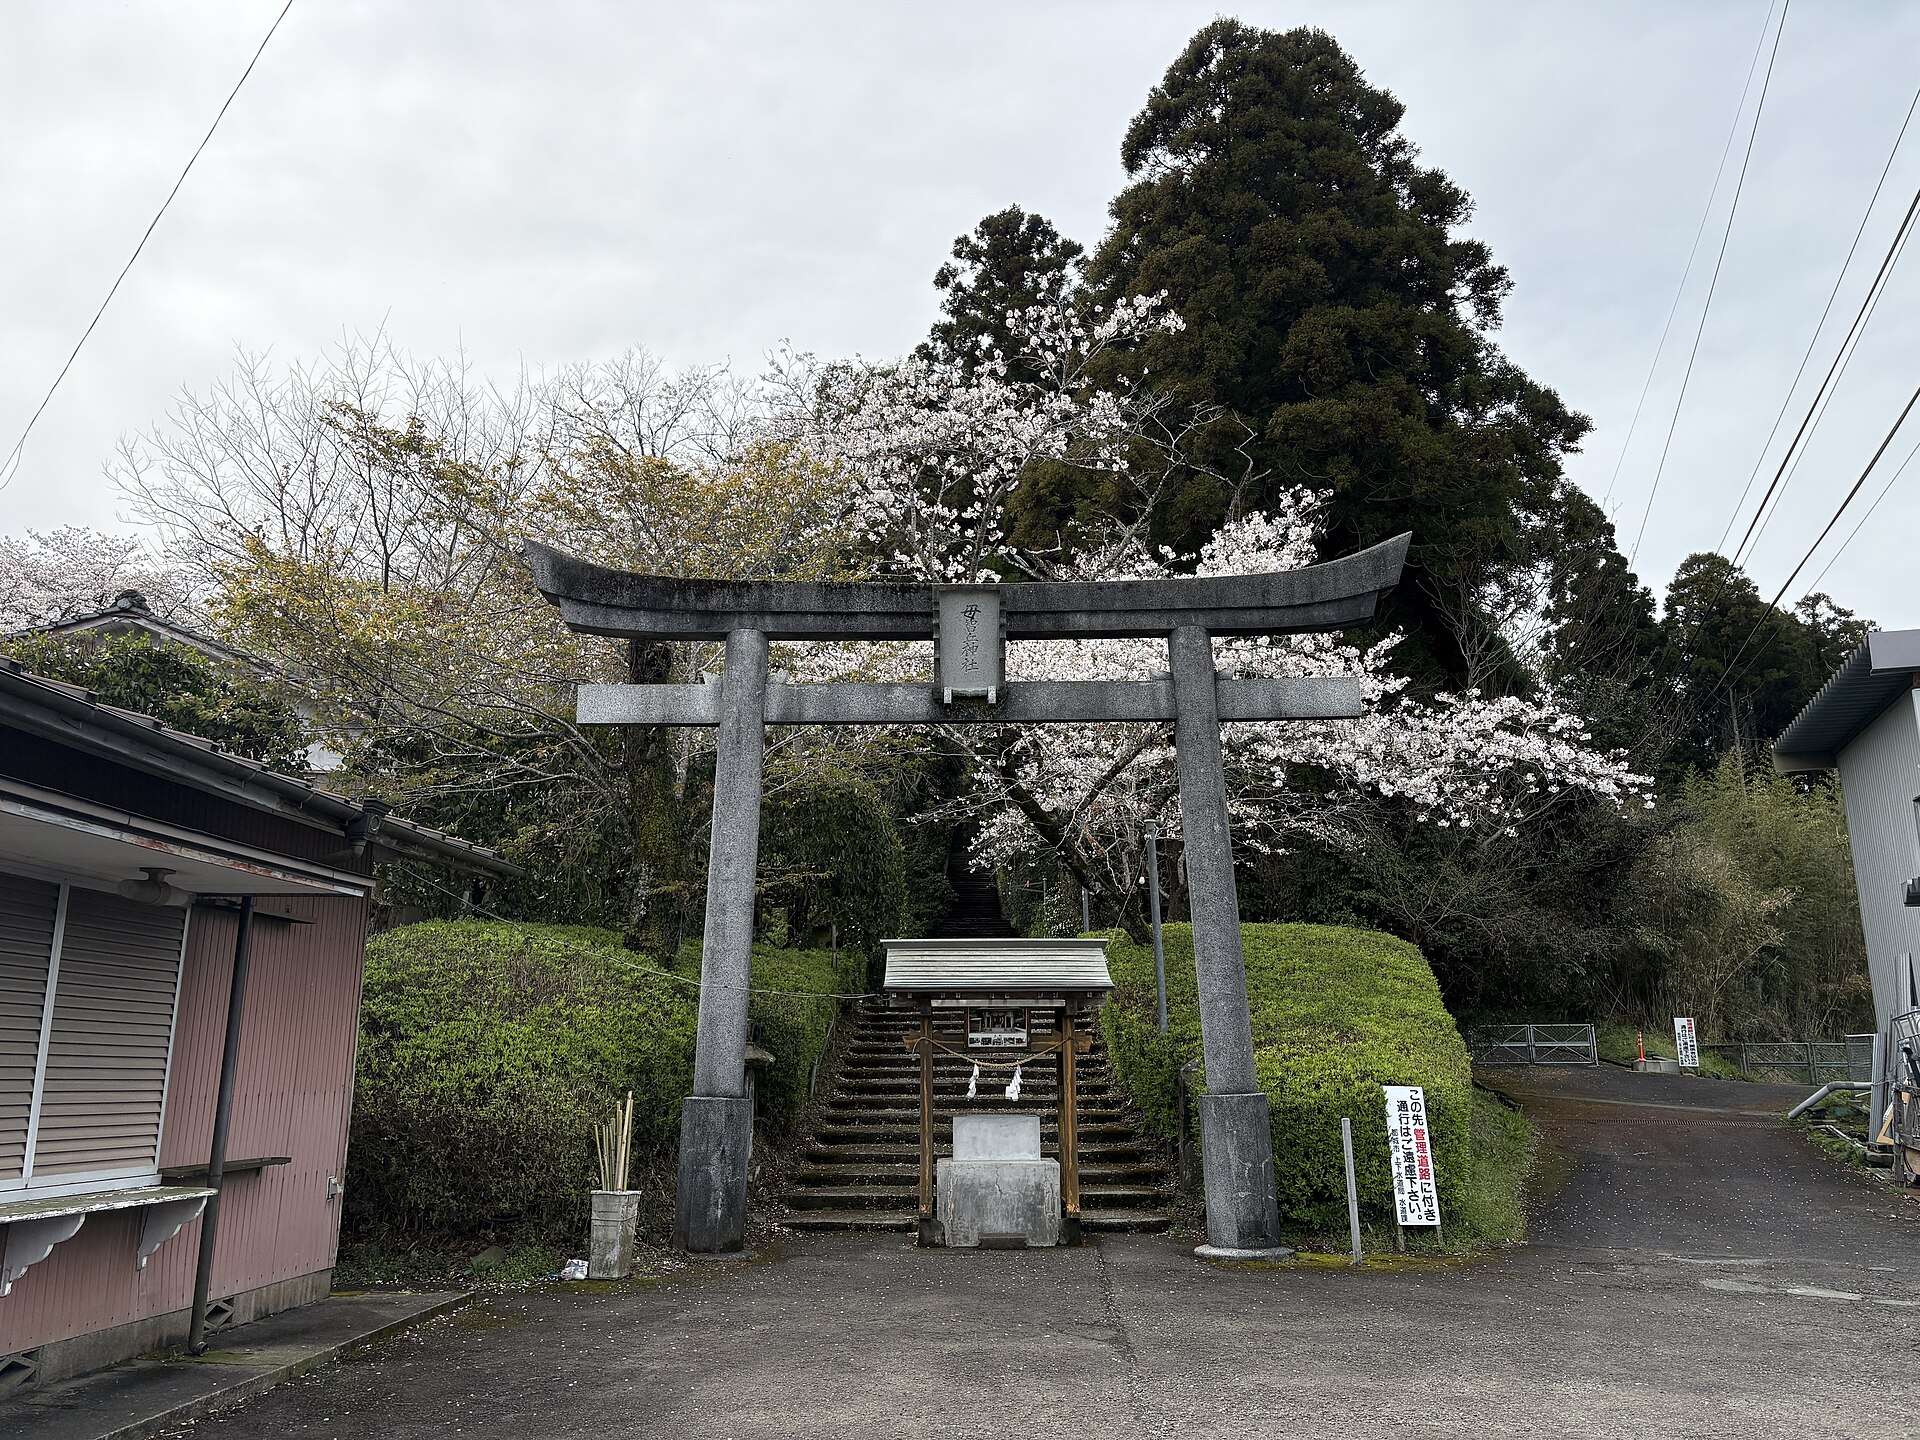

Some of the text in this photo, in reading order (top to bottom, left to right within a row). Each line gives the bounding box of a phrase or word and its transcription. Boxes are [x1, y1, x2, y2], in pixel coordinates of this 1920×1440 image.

[1396, 1100, 1423, 1220] 通行はご遠慮下さい。
